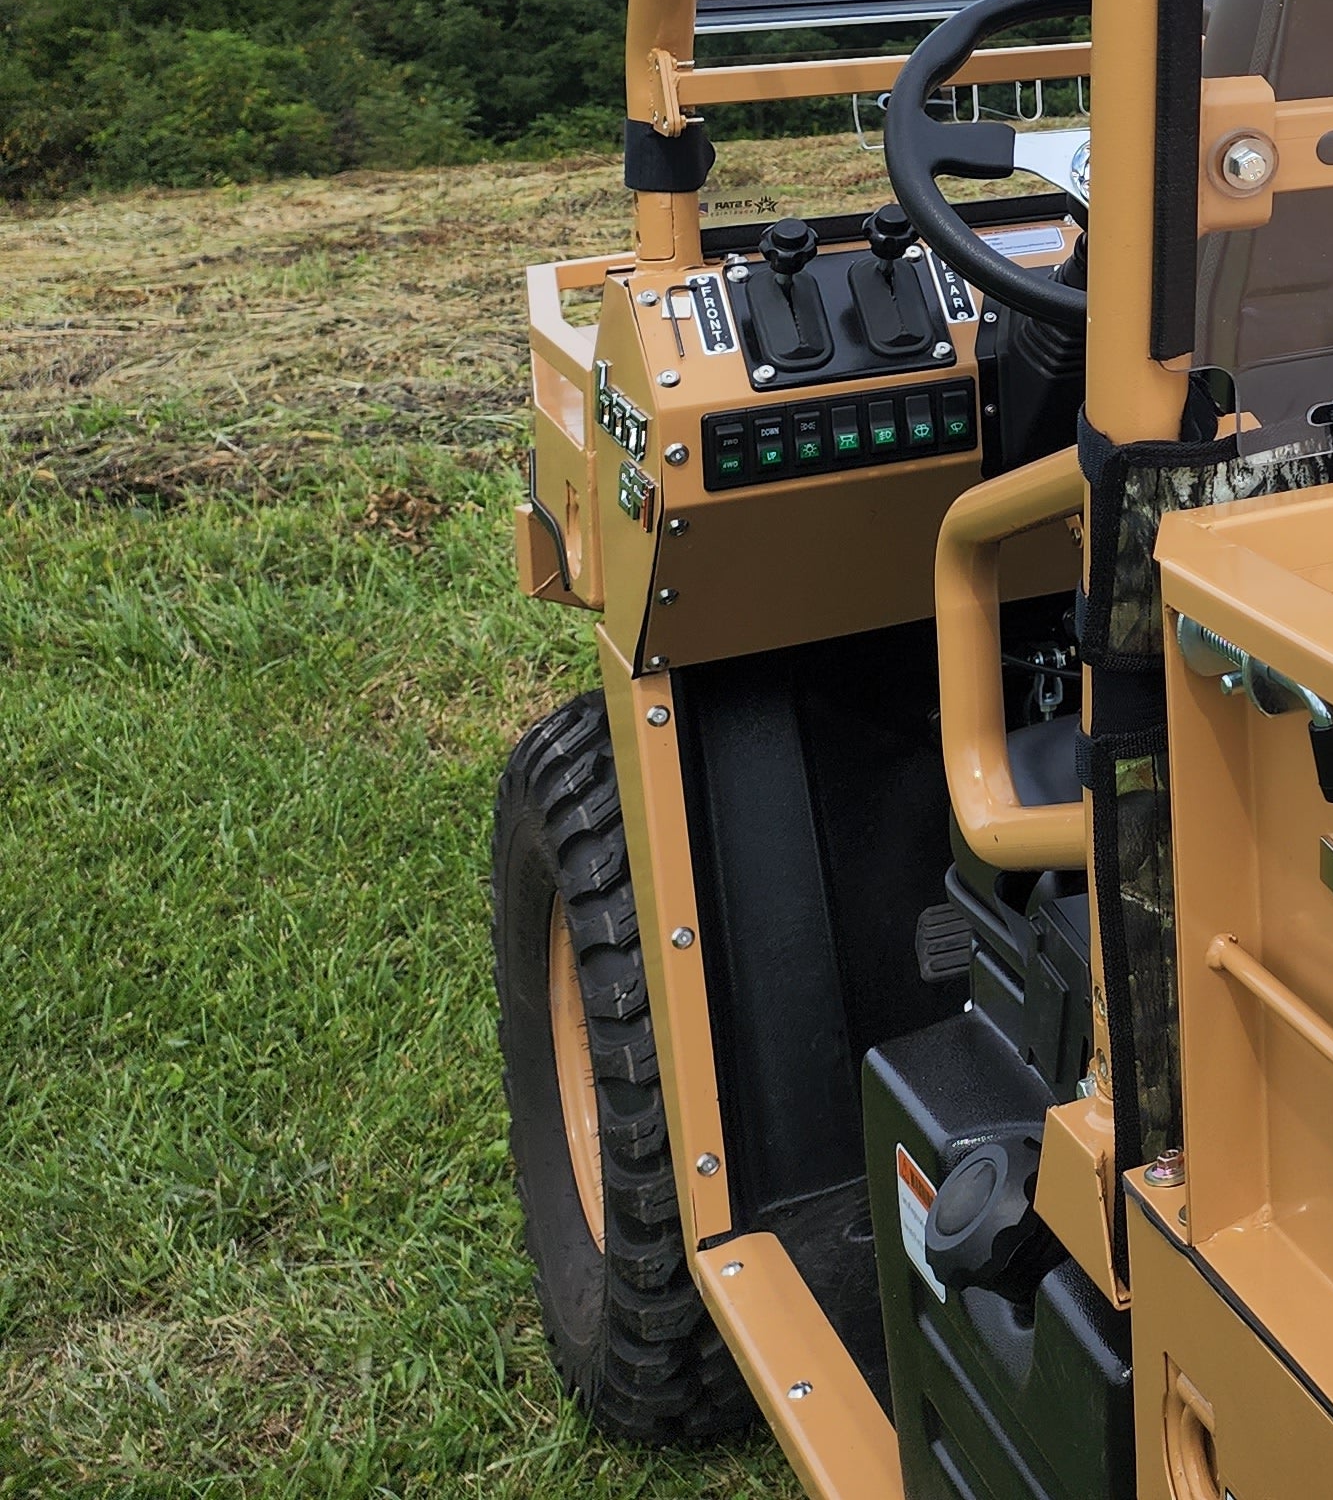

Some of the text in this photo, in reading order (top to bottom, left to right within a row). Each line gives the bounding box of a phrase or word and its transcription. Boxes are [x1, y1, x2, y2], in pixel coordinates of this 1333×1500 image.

[700, 286, 723, 341] FRONT
[760, 426, 780, 437] DOWN
[766, 451, 777, 461] UP
[722, 460, 739, 469] 4WD
